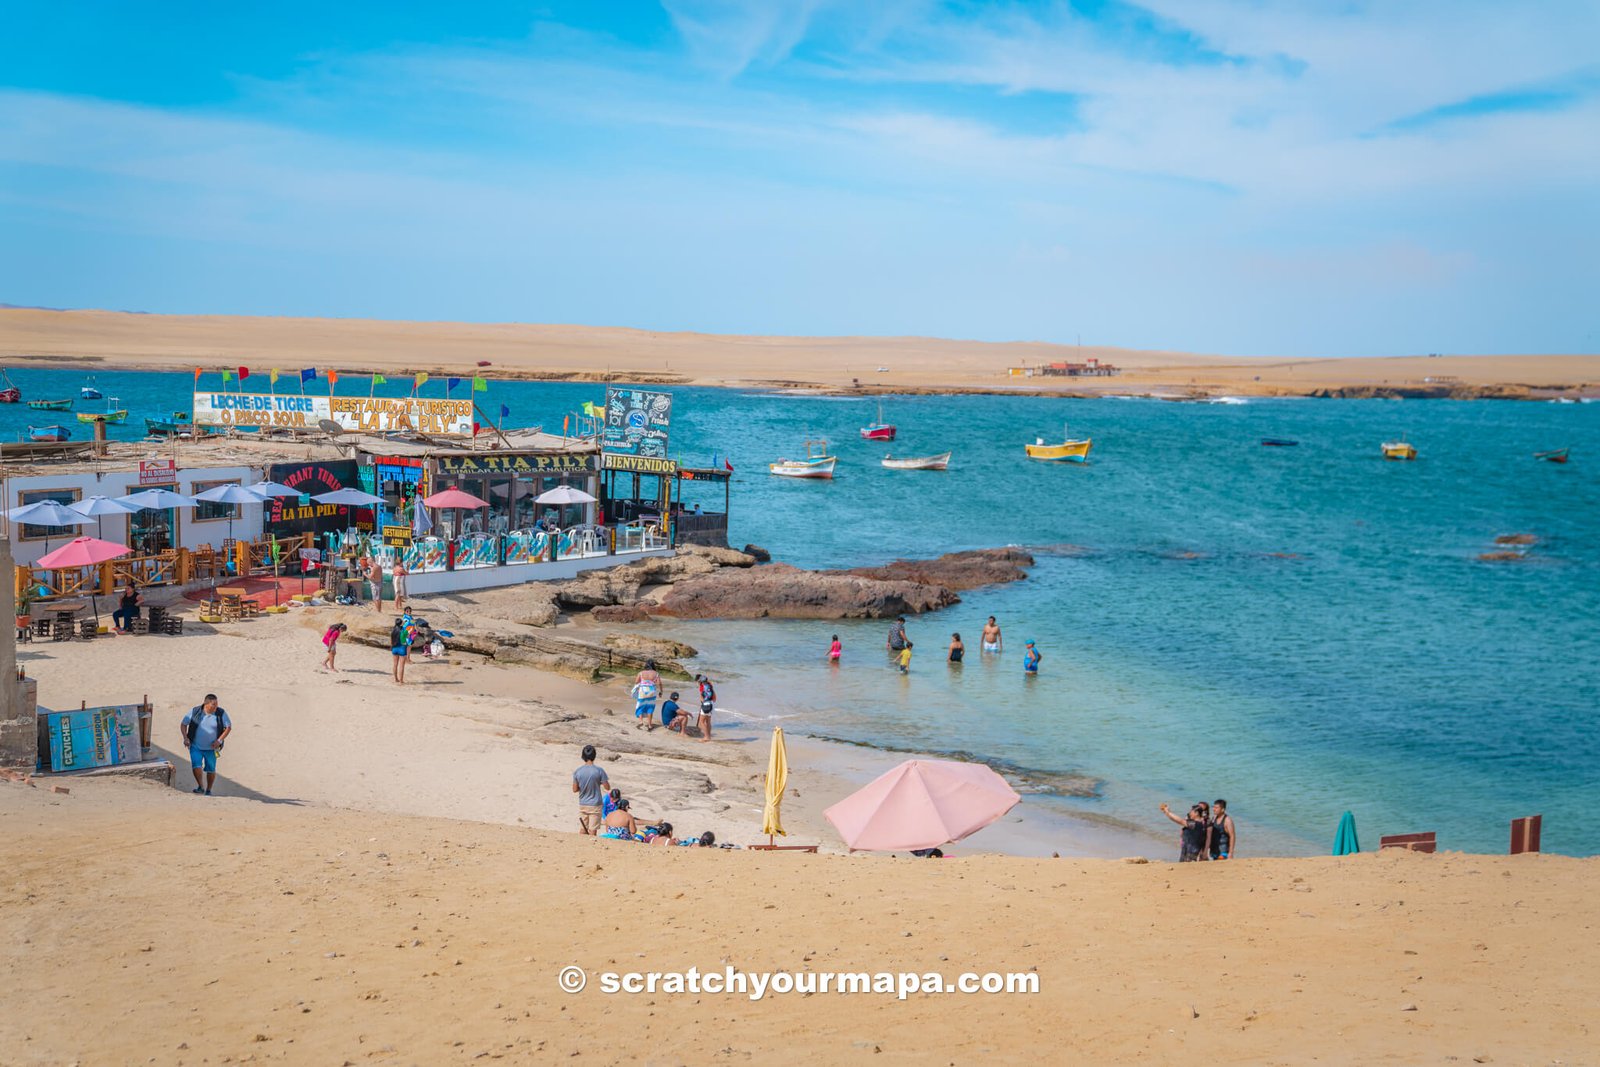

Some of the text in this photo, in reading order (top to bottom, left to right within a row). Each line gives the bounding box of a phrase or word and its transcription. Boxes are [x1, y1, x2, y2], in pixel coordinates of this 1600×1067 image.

[211, 395, 313, 411] LECHE DE TIGRE
[417, 400, 471, 416] TURISTICO
[221, 410, 306, 427] O PISCO SOUR
[387, 414, 412, 430] TIA
[443, 455, 590, 469] LA TIA PILY
[606, 455, 676, 472] BIENVENIDOS
[271, 467, 313, 522] RESTURANT
[318, 467, 347, 515] TURISO
[282, 504, 337, 521] LA TIA PILY
[62, 717, 73, 766] CEVICHES
